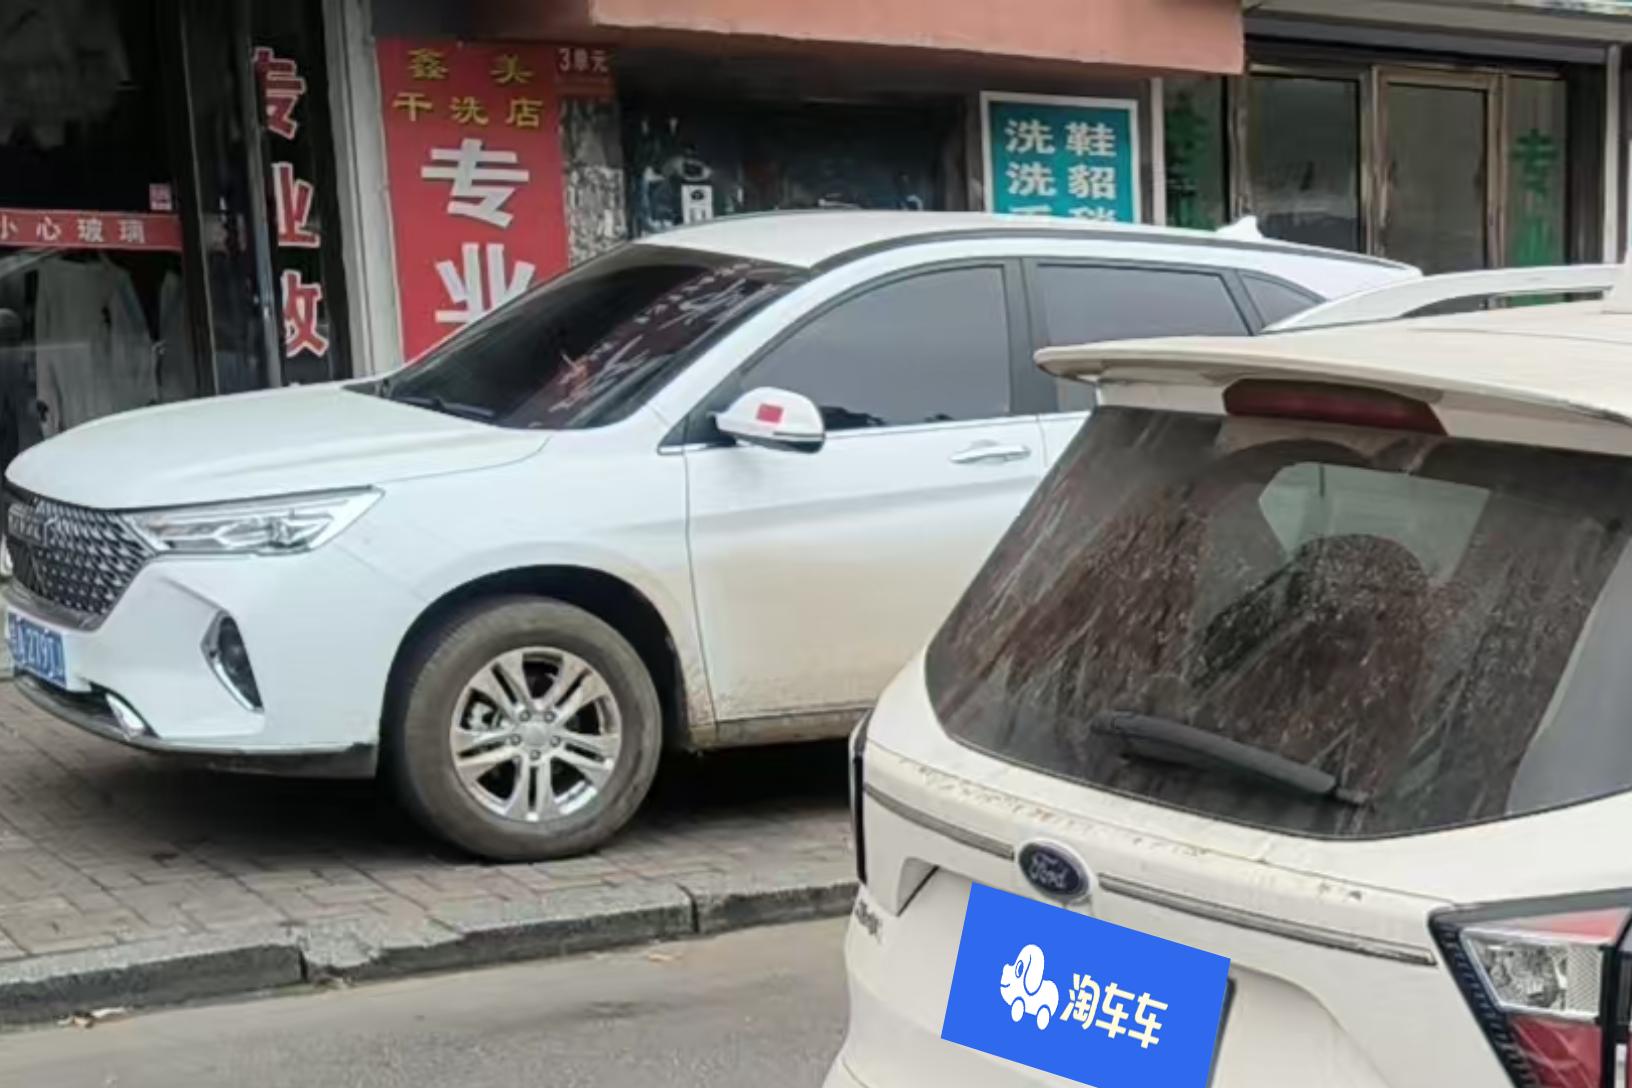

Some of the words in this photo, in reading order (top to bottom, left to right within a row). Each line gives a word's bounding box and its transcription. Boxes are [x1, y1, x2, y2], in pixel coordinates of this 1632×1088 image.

[392, 92, 544, 127] 干洗店
[1005, 119, 1117, 157] 洗鞋
